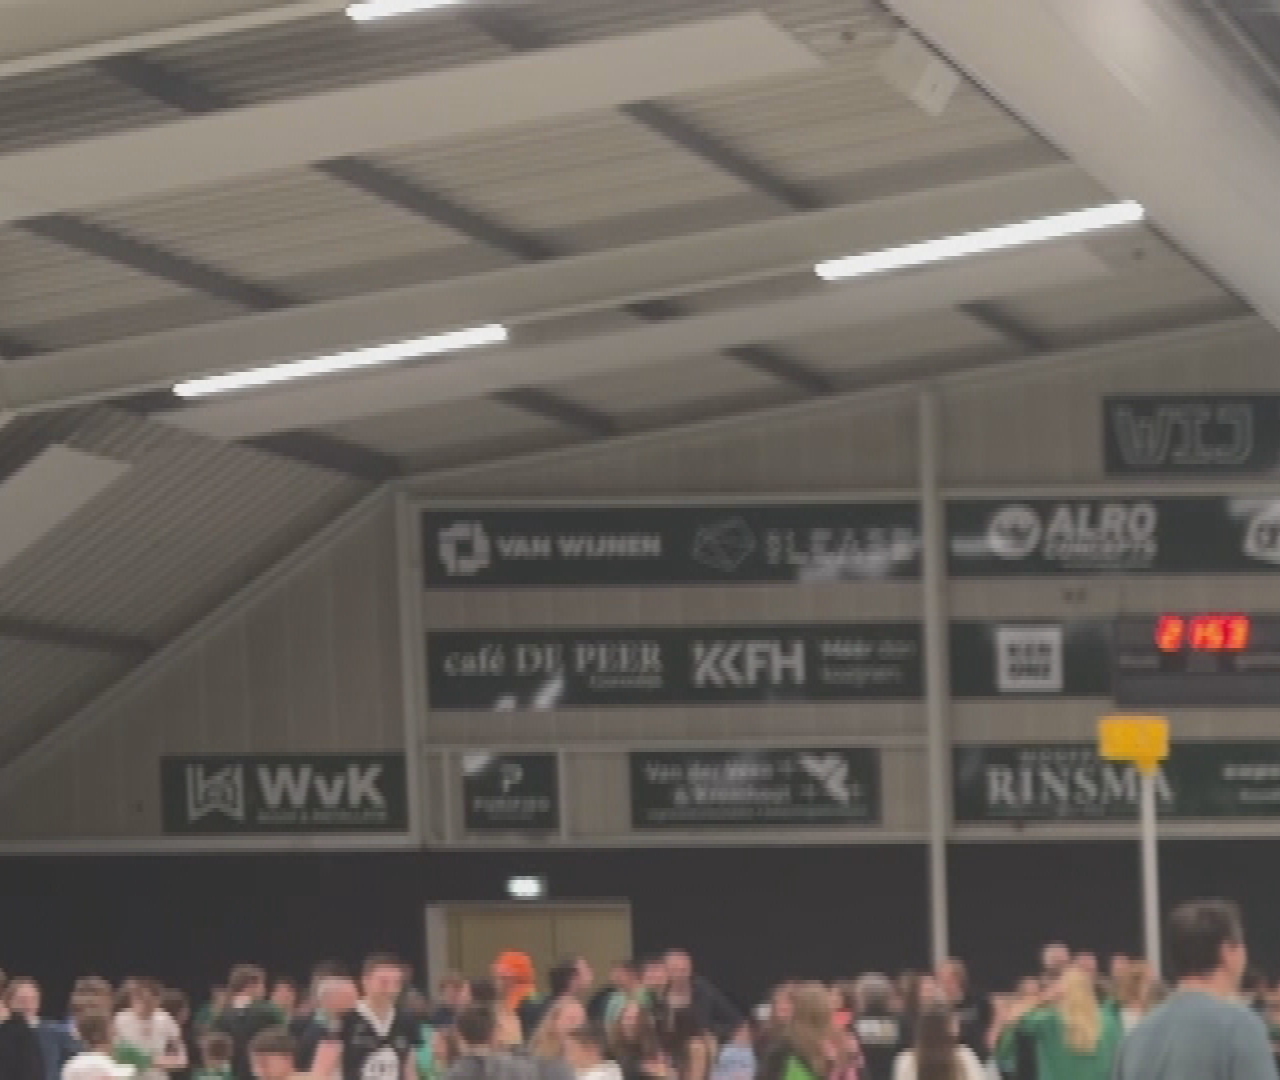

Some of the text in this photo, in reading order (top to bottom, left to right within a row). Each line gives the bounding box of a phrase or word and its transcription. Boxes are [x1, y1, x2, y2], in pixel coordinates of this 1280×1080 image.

[1047, 503, 1157, 539] ALRO
[498, 534, 662, 558] VAN WIJNEN
[258, 764, 385, 806] WvK
